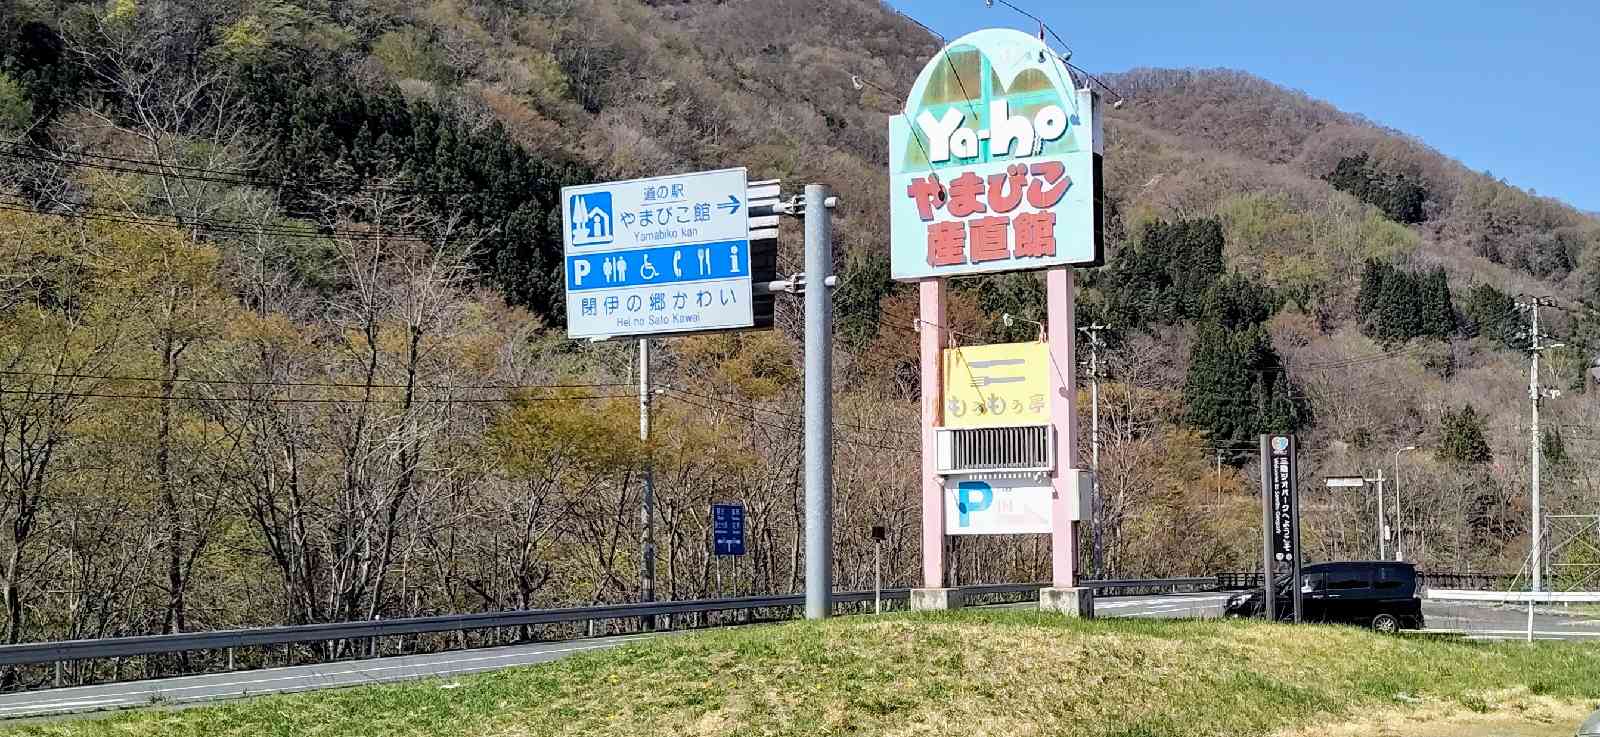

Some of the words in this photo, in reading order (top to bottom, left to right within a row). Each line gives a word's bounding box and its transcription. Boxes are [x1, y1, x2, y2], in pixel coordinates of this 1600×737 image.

[916, 100, 1068, 163] Ya-ho
[643, 184, 684, 201] 道の駅
[907, 161, 1073, 221] やまびこ
[620, 202, 711, 229] やまびこ館
[634, 229, 678, 242] Yamabiko
[681, 227, 698, 239] kan
[927, 210, 1056, 267] 産直館
[581, 287, 737, 317] 閉伊の郷かわい
[648, 313, 670, 327] Sato
[672, 311, 700, 324] Kawai
[959, 480, 993, 528] P
